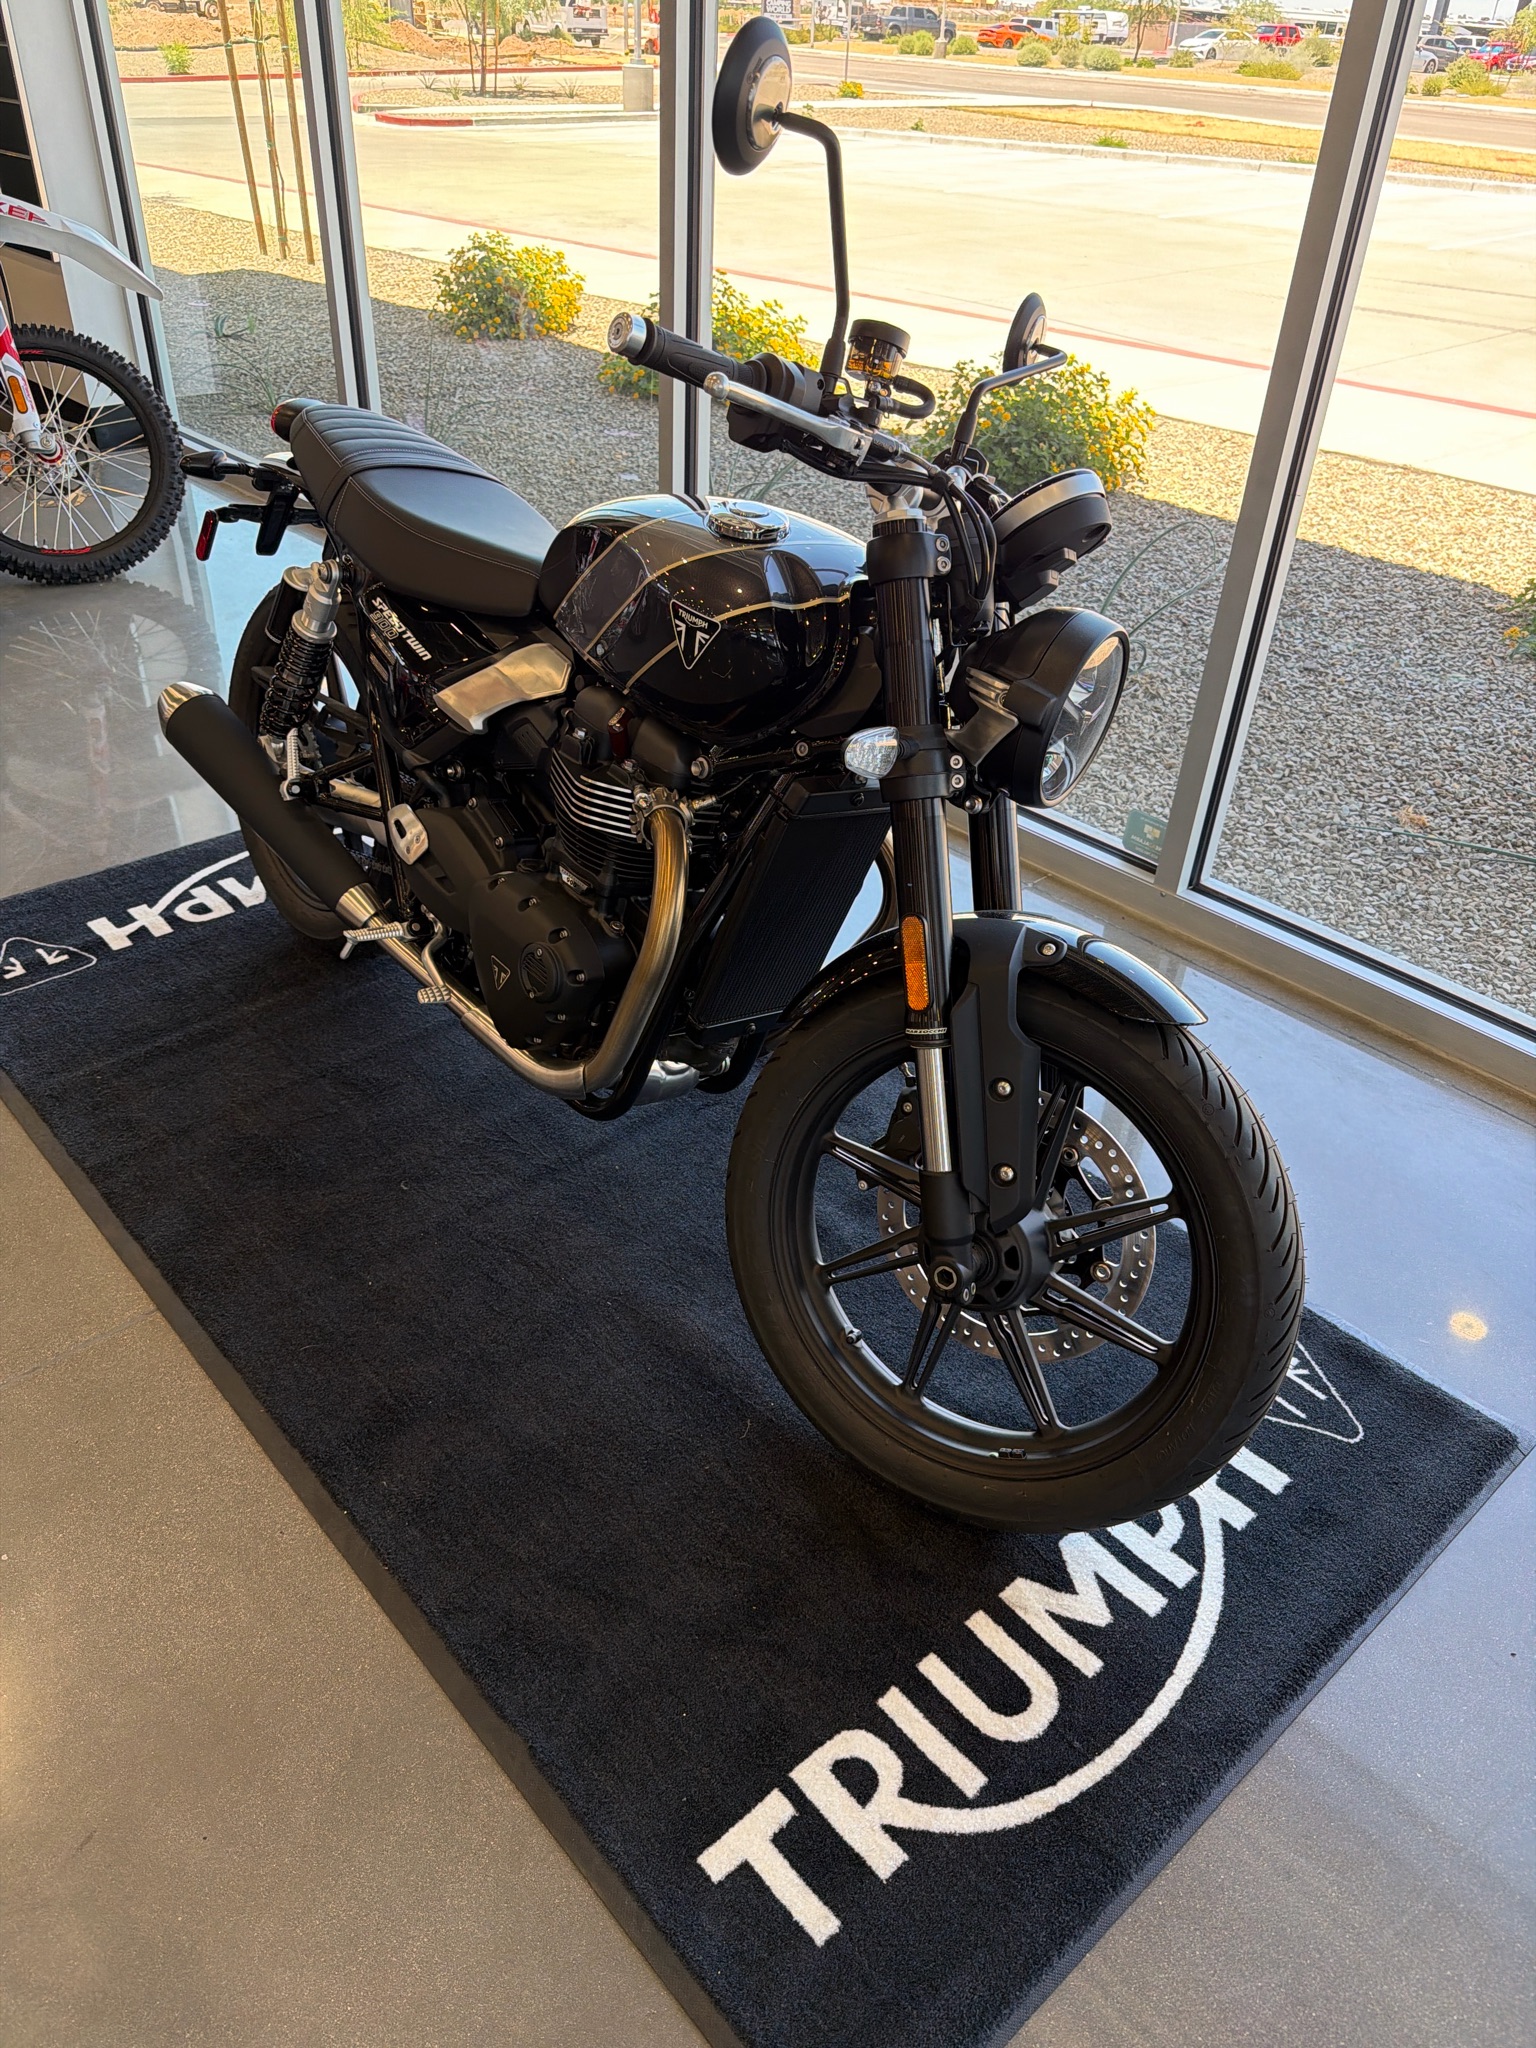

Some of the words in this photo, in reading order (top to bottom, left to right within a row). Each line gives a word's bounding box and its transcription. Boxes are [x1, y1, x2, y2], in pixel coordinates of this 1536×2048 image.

[766, 5, 792, 14] WORLD
[370, 610, 399, 640] 900
[371, 597, 406, 633] SPEED
[401, 630, 432, 661] TWIN
[678, 608, 709, 630] TRIUMPH
